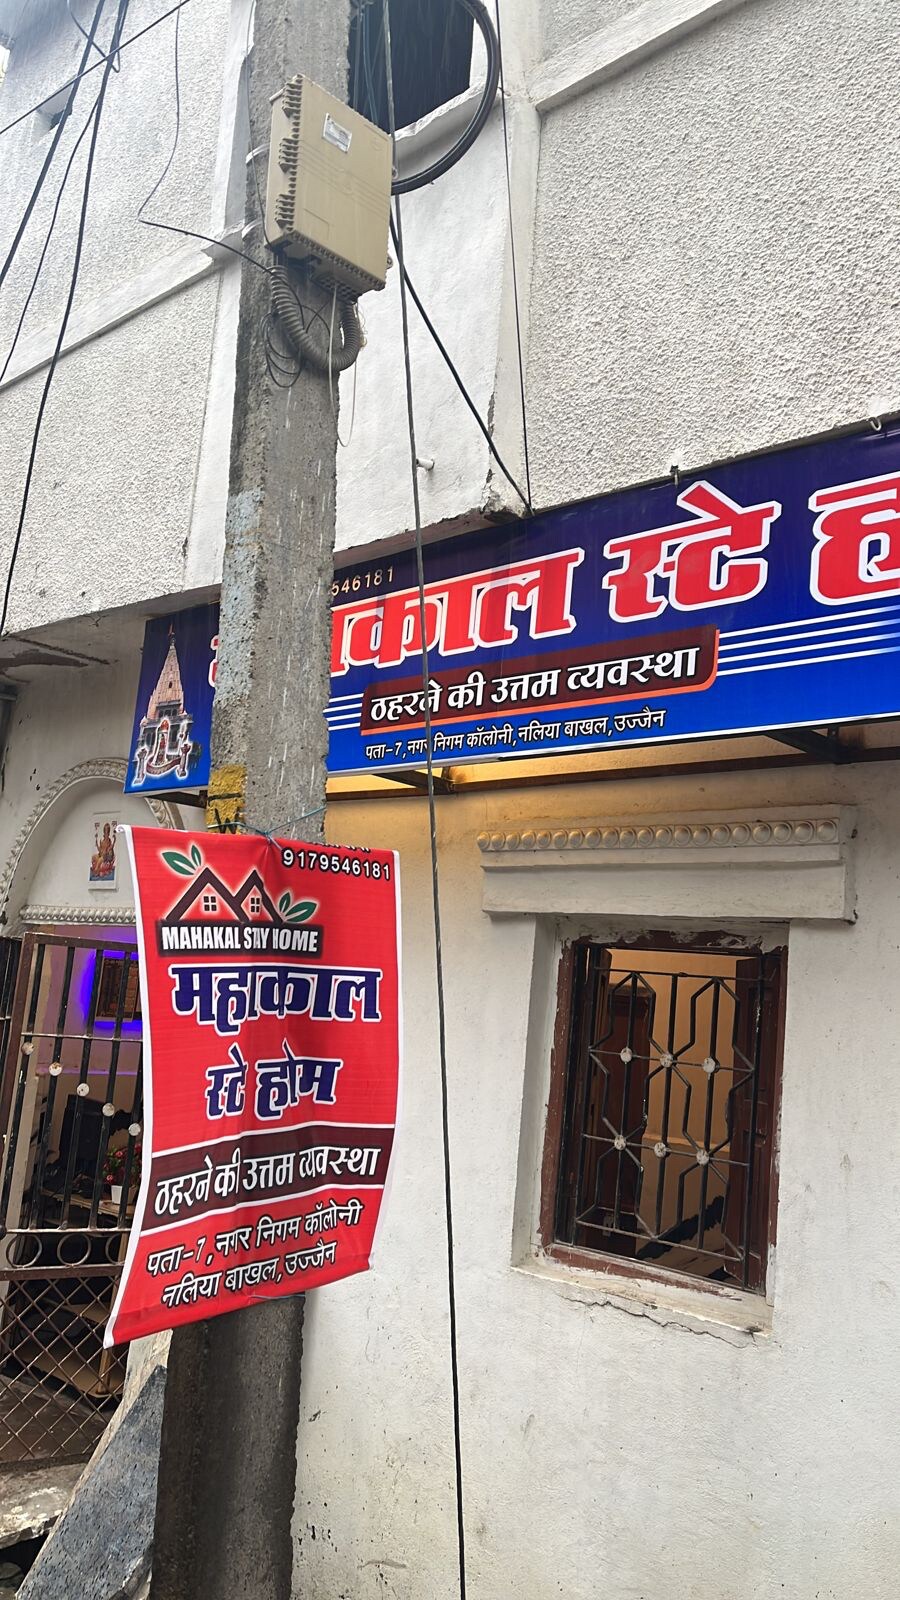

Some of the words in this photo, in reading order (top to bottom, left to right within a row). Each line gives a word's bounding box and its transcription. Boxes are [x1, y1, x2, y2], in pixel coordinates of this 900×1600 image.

[602, 480, 782, 623] स्टे
[370, 679, 443, 722] ठहरने
[447, 671, 486, 709] की
[491, 669, 561, 703] उत्तम
[567, 647, 700, 689] व्यवस्था
[433, 732, 464, 752] निगम
[283, 849, 391, 880] 9179546181
[161, 926, 241, 950] MAHAKAL
[243, 927, 270, 949] STAY
[272, 928, 319, 952] HOME
[168, 963, 383, 1036] महाकाल
[205, 1042, 248, 1120] स्टे
[254, 1037, 344, 1121] होम
[154, 1155, 214, 1216] ठहरने
[214, 1148, 241, 1197] की
[242, 1153, 296, 1191] उत्तम
[299, 1146, 382, 1178] व्यवस्था
[255, 1217, 302, 1247] निगम
[304, 1199, 363, 1234] कॉलोनी
[162, 1272, 223, 1307] नलिया
